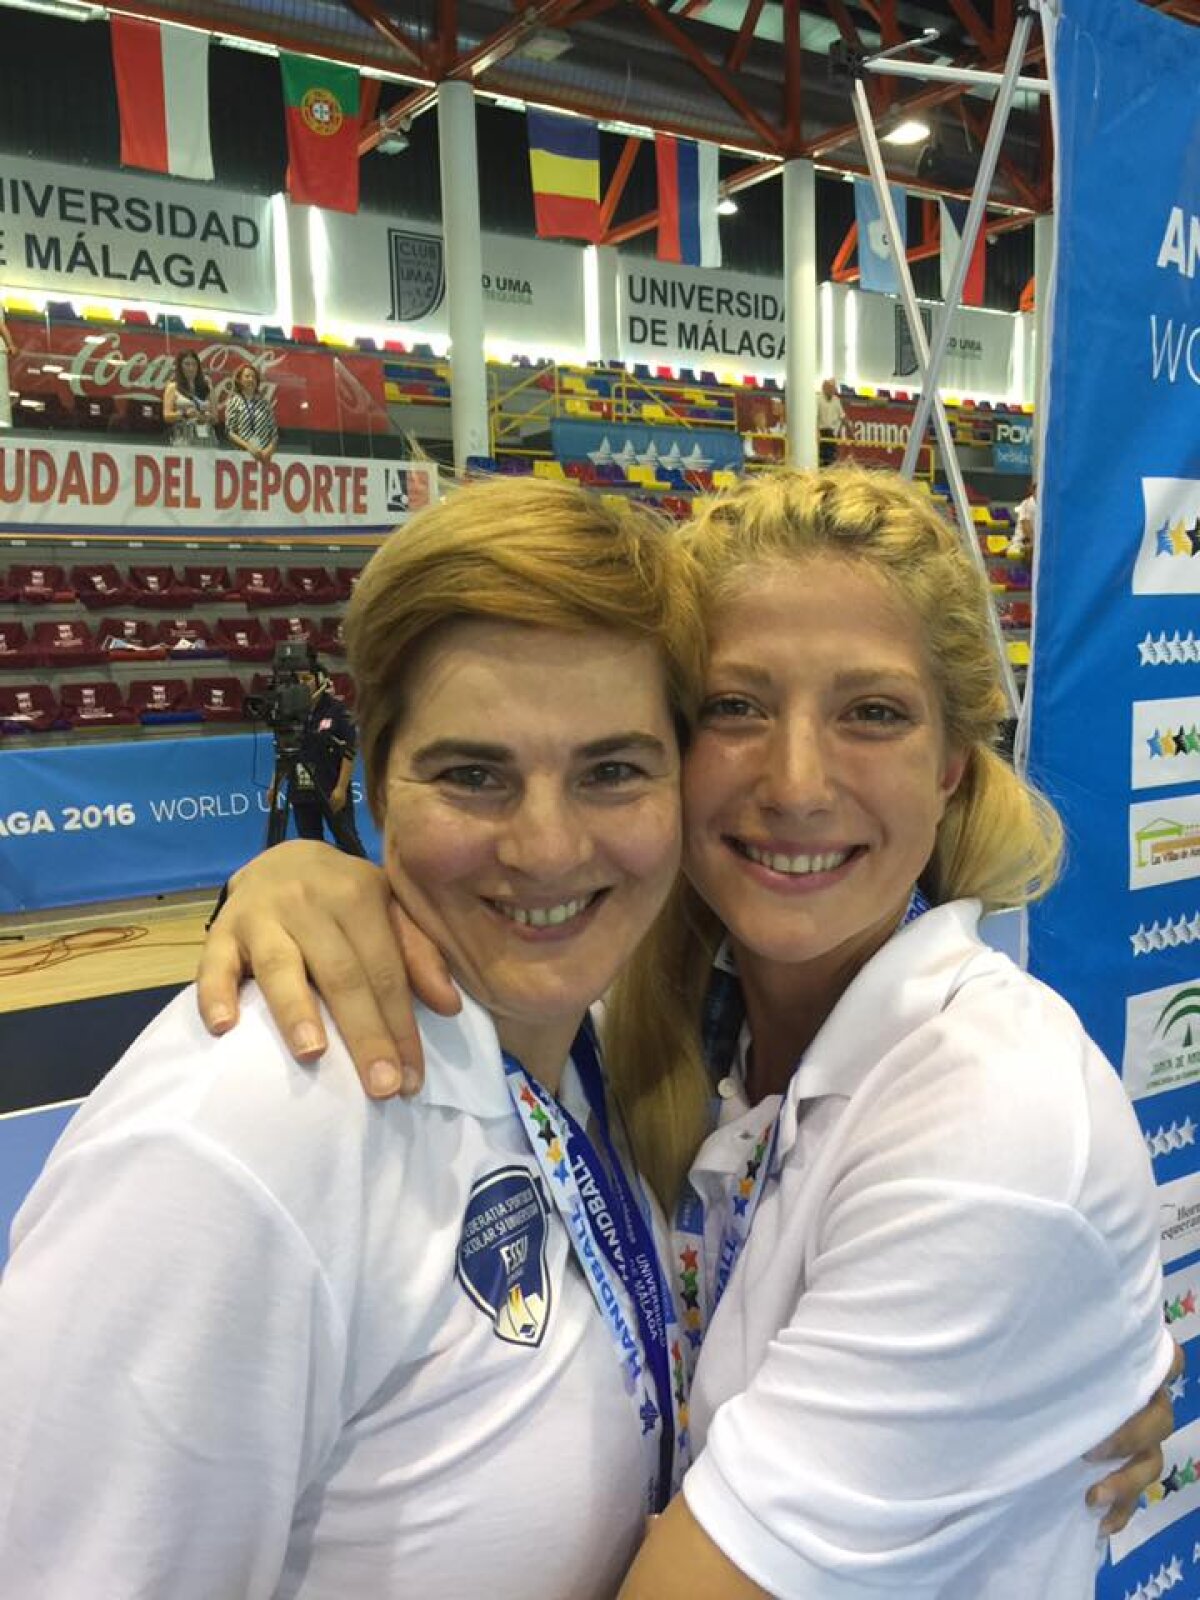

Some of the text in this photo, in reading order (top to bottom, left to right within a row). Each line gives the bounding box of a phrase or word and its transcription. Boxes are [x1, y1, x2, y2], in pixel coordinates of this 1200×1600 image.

[0, 177, 261, 249] IVERSIDAD
[24, 231, 229, 294] MÁLAGA
[496, 276, 533, 295] UMA
[628, 274, 785, 323] UNIVERSID
[629, 315, 668, 347] DE
[134, 454, 201, 509] DEL
[214, 458, 368, 515] DEPORTE
[62, 802, 136, 831] 2016
[149, 792, 250, 823] WORLD
